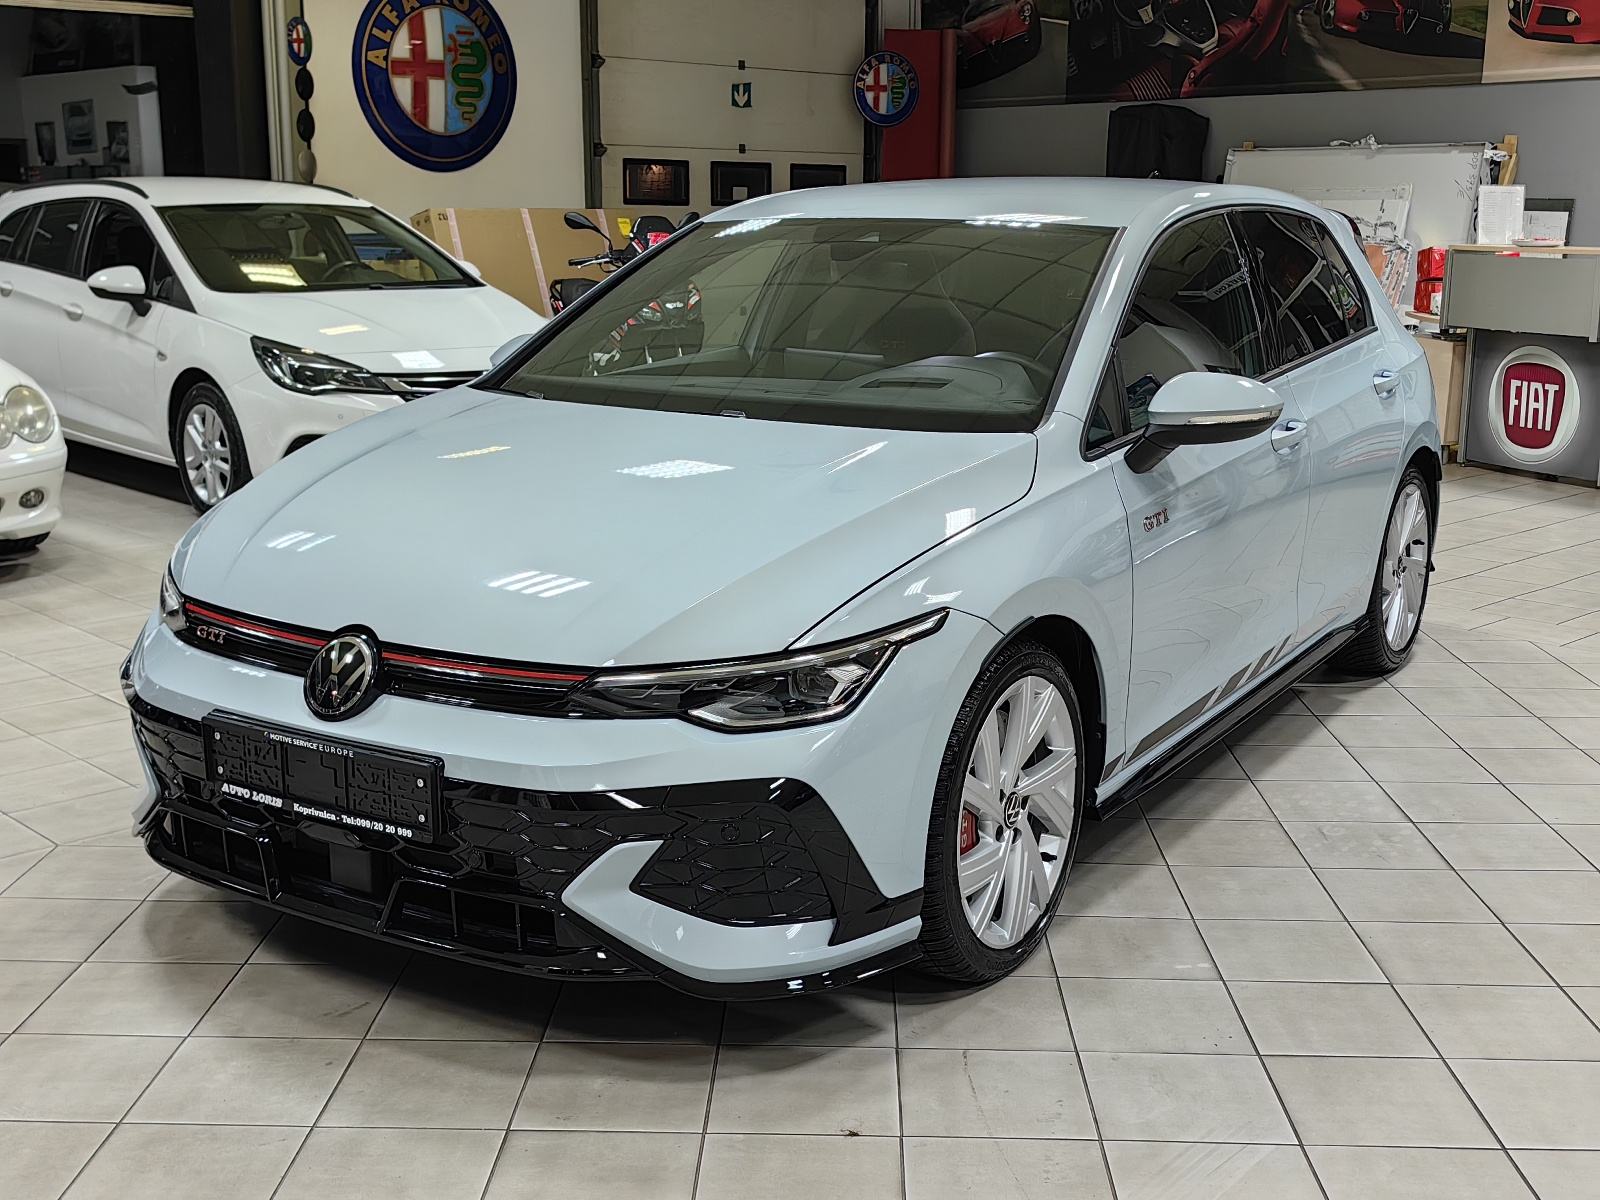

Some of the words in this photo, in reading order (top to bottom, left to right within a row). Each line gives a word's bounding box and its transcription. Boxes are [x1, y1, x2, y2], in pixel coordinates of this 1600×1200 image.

[367, 0, 420, 69] ALFA
[436, 0, 507, 74] OMEO
[1508, 379, 1560, 432] FIAT
[1143, 507, 1170, 533] GTI
[196, 625, 226, 644] GTI
[292, 738, 318, 750] SERVICE
[318, 744, 354, 758] EUROPE
[221, 782, 251, 799] AUTO
[251, 791, 283, 808] LORIS
[293, 803, 337, 821] Koprivnica
[385, 824, 396, 834] 20
[397, 827, 413, 838] 999
